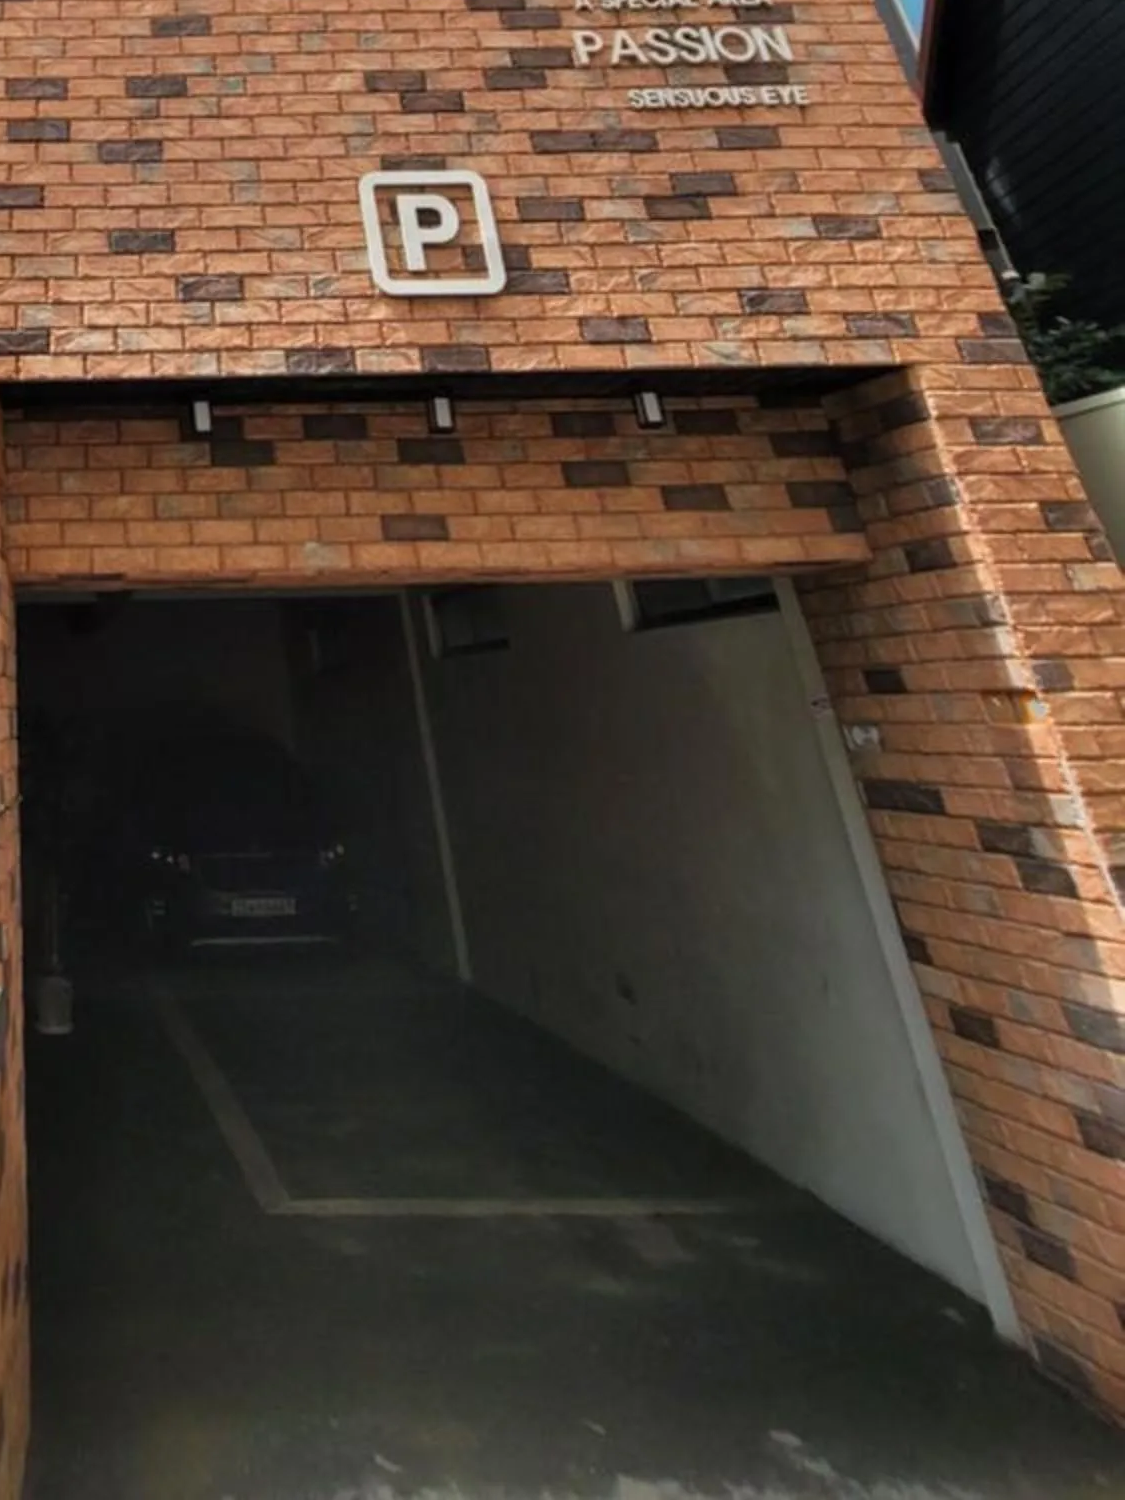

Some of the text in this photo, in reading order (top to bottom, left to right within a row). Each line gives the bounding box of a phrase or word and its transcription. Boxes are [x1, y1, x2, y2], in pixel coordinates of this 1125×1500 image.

[572, 26, 793, 66] PASSION
[627, 85, 810, 110] SENSUOUS EYE
[395, 193, 461, 272] P
